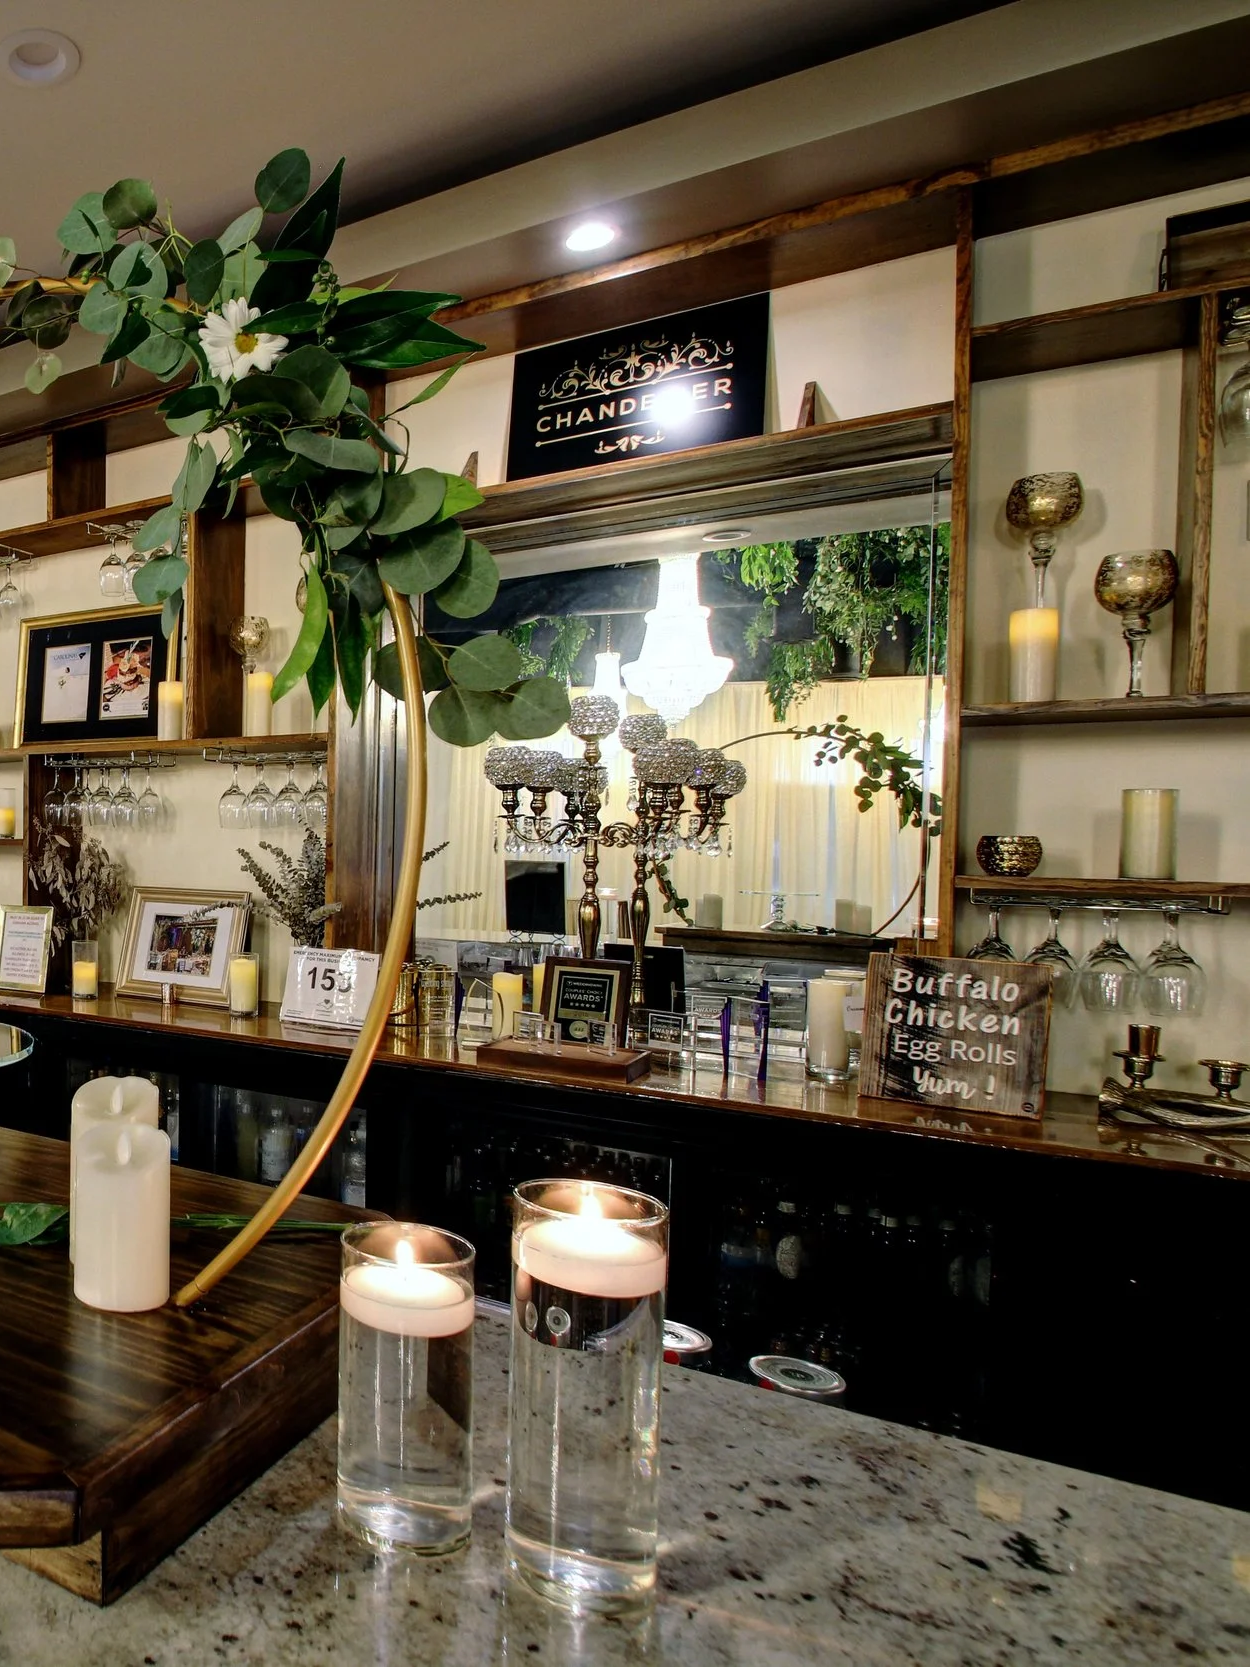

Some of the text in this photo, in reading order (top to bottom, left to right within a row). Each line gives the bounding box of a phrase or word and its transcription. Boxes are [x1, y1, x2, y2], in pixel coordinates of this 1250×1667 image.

[536, 378, 732, 433] CHANDEER
[892, 968, 1020, 1002] Buffalo
[885, 998, 1020, 1036] Chicken
[893, 1033, 1017, 1066] Egg Rolls
